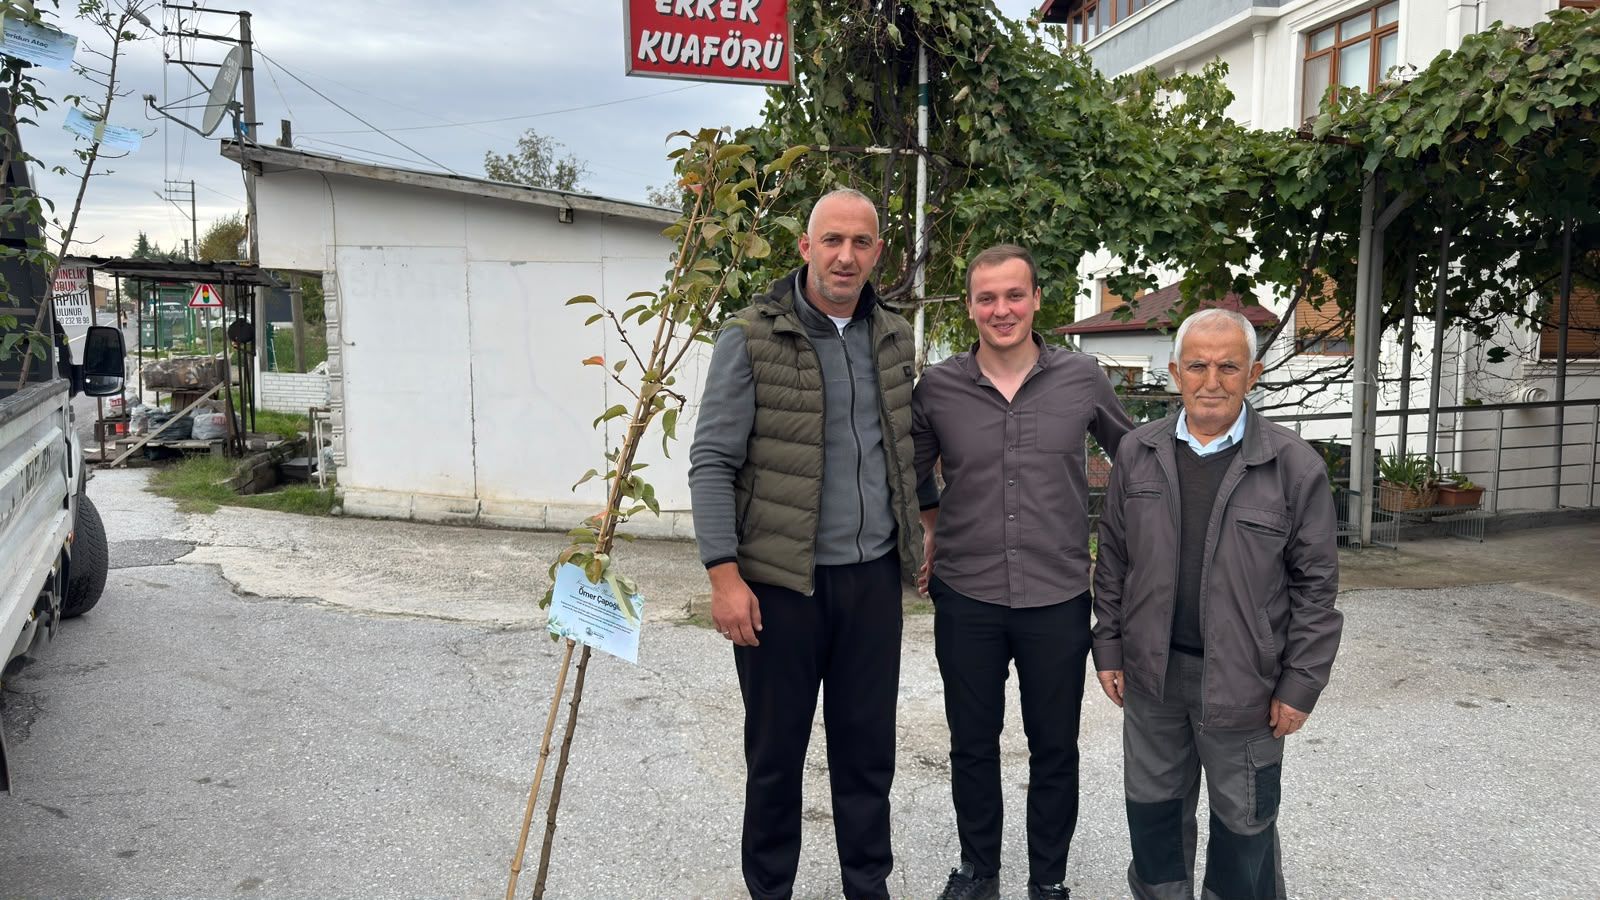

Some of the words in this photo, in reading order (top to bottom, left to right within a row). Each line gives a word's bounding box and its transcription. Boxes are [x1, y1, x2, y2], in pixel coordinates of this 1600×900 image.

[637, 29, 784, 71] KUAFÖRÜ
[56, 308, 82, 317] ULUNUR
[578, 586, 597, 601] Ömer
